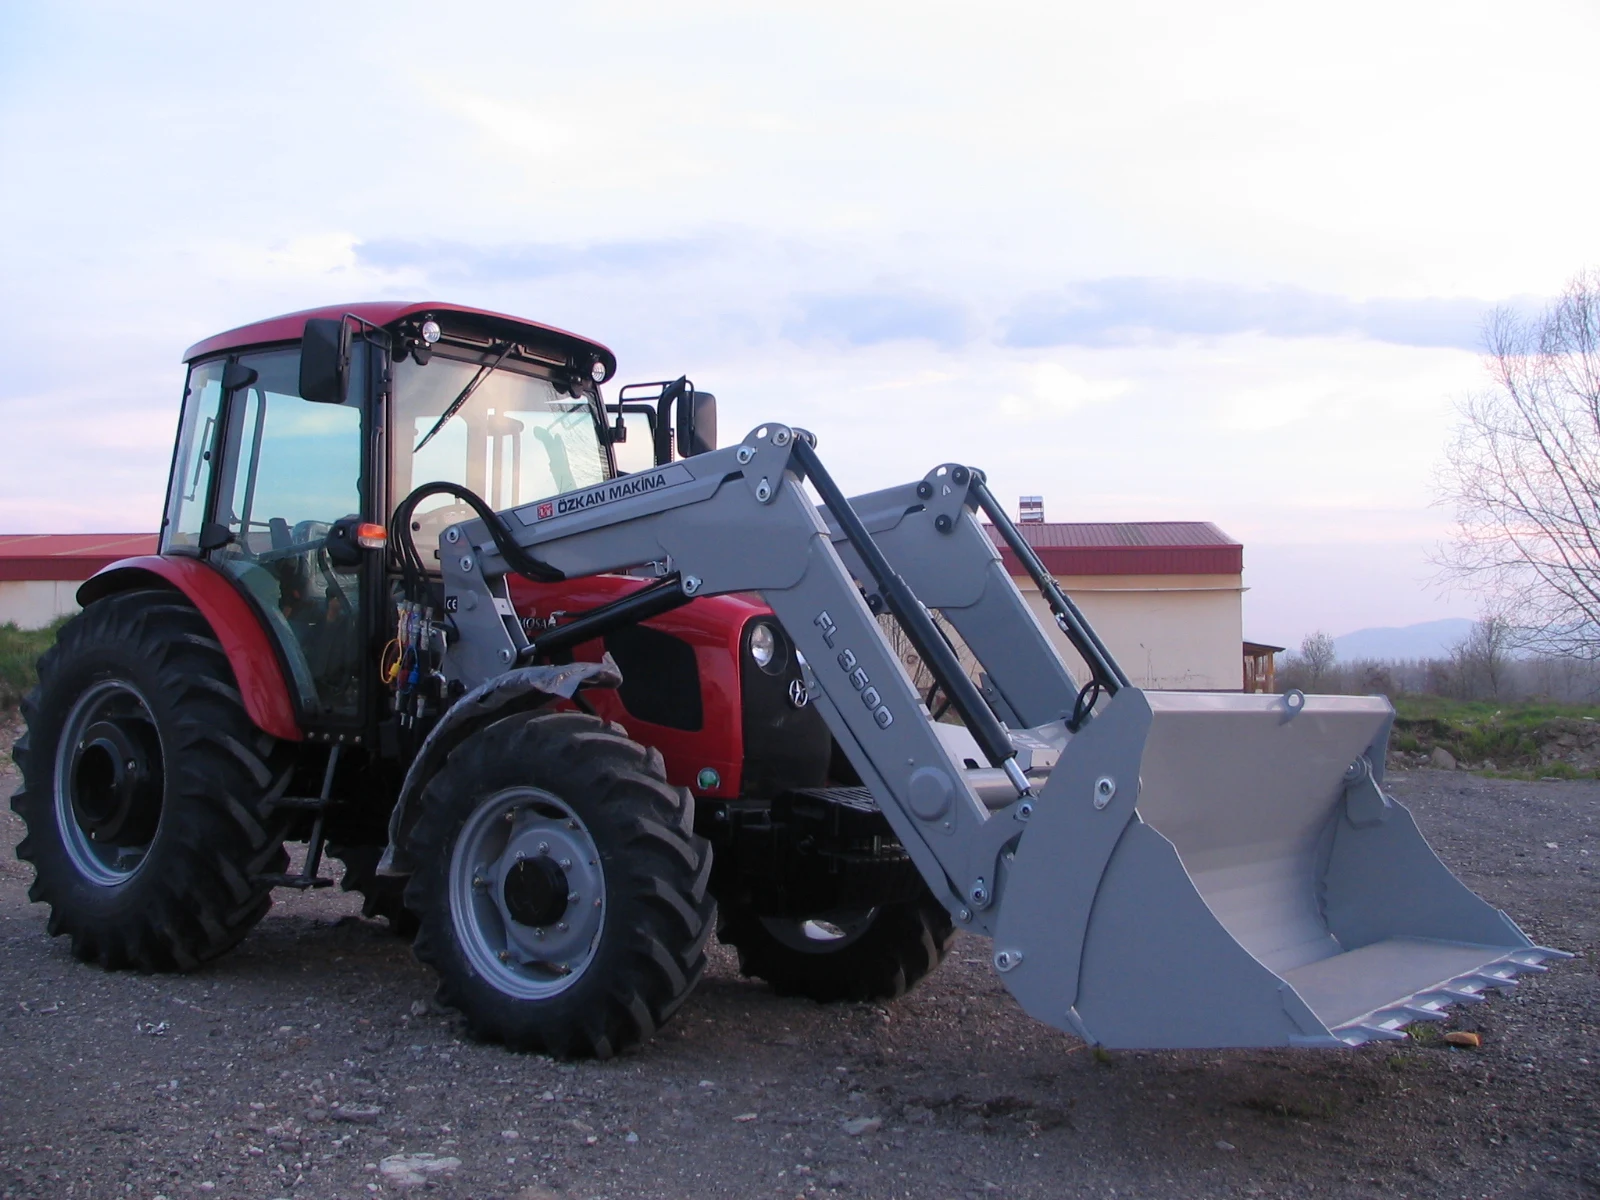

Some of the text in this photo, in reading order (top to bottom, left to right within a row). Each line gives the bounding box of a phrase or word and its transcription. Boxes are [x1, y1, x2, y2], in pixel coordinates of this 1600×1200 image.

[557, 491, 605, 514] ÖZKAN
[609, 474, 666, 499] MAKİNA
[446, 599, 457, 610] CE
[813, 610, 894, 730] FL 3500
